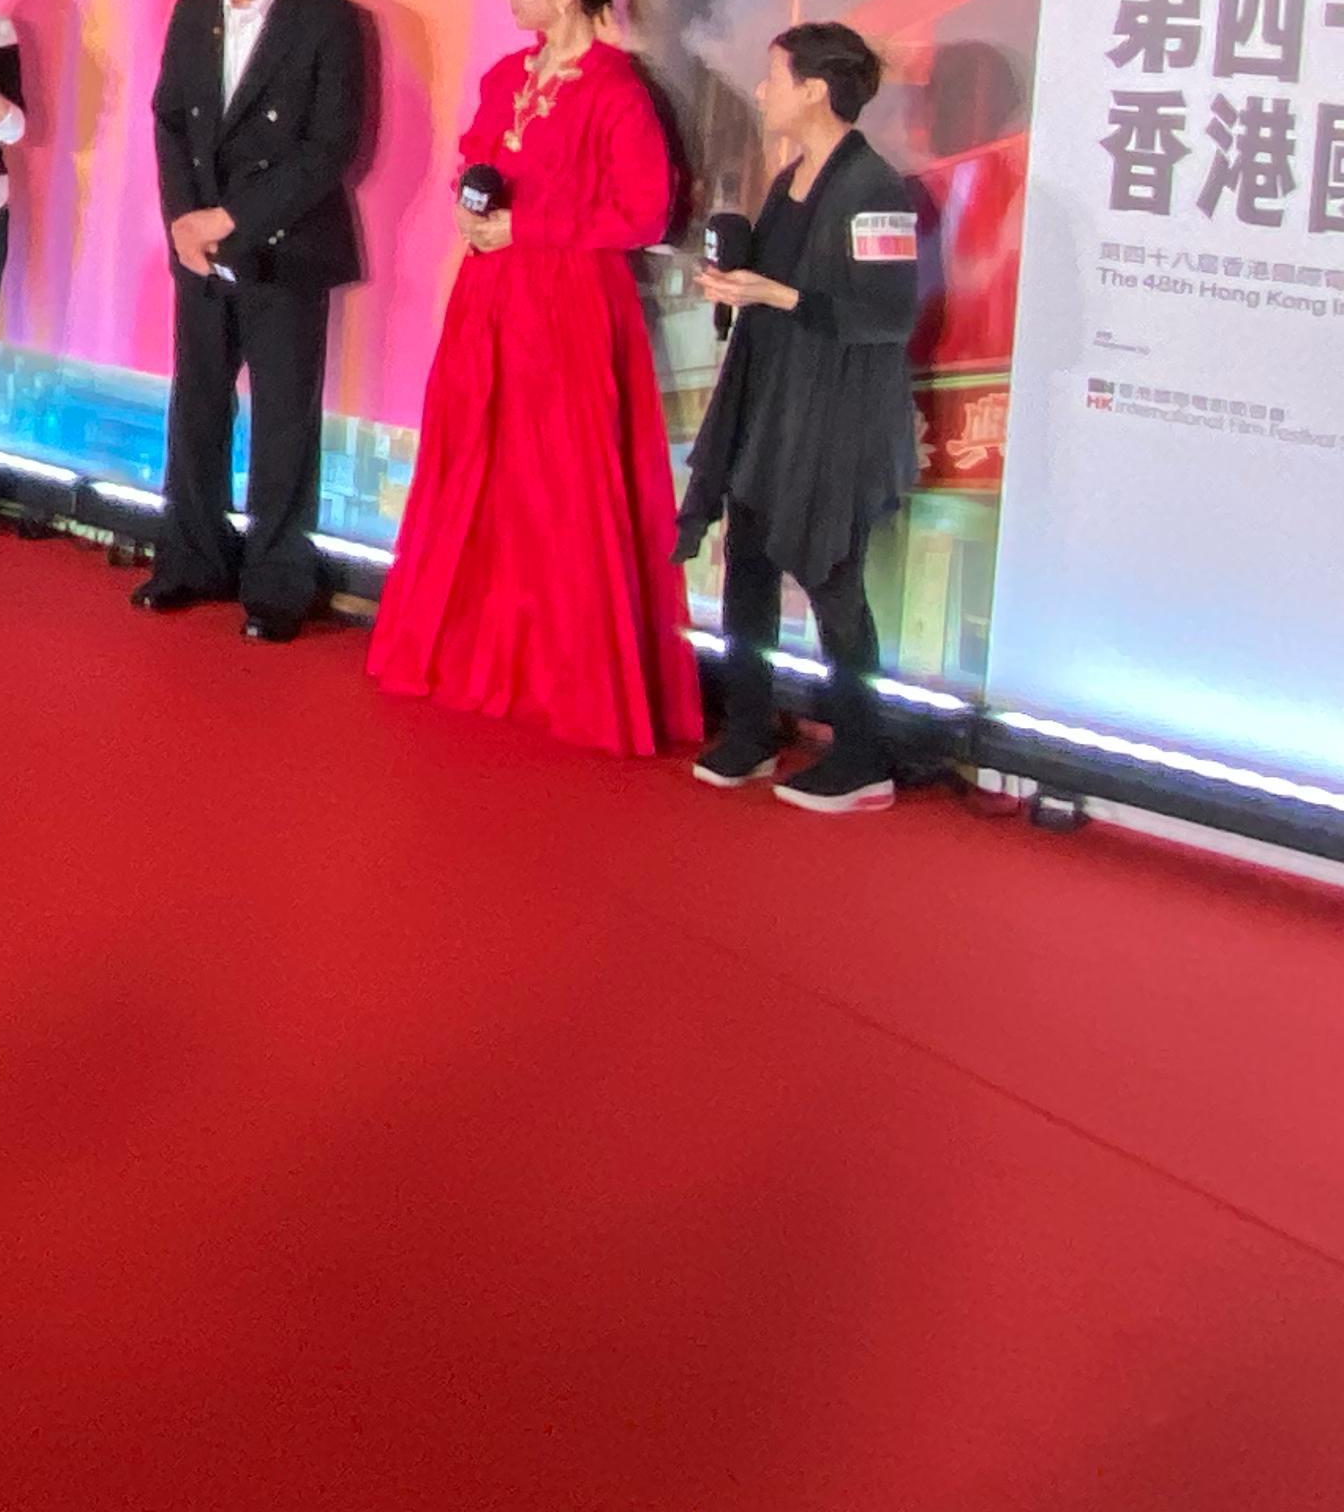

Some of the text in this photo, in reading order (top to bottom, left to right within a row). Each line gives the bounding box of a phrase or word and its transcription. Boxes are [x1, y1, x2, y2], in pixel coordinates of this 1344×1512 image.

[1096, 266, 1138, 289] The
[1142, 273, 1194, 296] 48th
[1199, 281, 1261, 309] Hong
[1266, 290, 1327, 318] Kong
